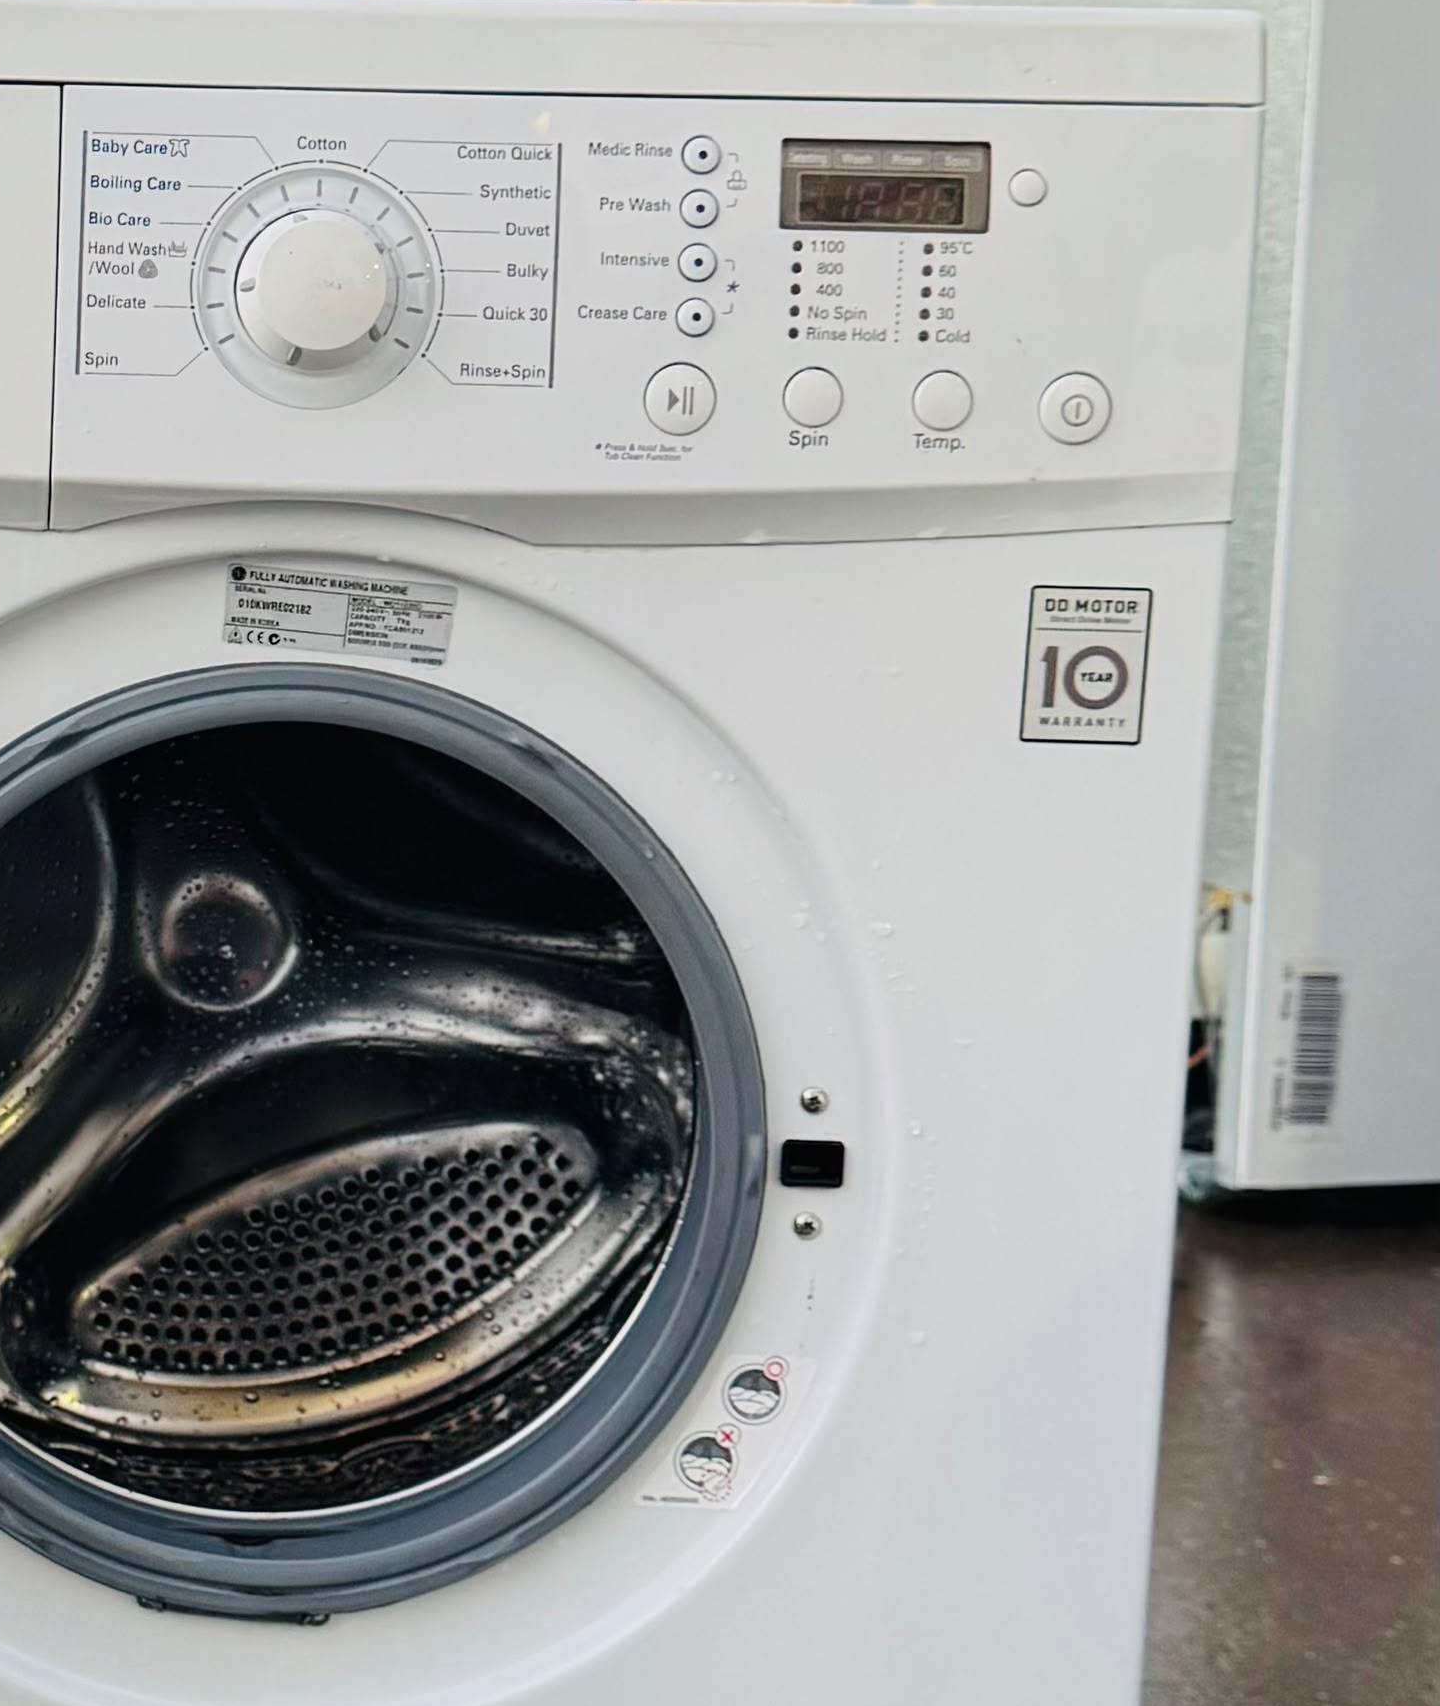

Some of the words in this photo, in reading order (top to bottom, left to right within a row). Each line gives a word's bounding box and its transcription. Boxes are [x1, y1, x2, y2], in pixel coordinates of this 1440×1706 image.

[91, 139, 129, 157] Baby
[133, 140, 168, 156] Care
[296, 136, 347, 151] Cotton
[588, 142, 631, 159] Medic
[634, 142, 673, 160] Rinse
[457, 146, 506, 160] Cotton
[510, 146, 552, 162] Quick
[90, 175, 143, 194] Boiling
[147, 177, 181, 191] Care
[480, 184, 551, 201] Synthetic
[600, 196, 622, 212] Pre
[627, 197, 671, 213] Wash
[88, 212, 112, 226] Bio
[115, 213, 151, 227] Care
[505, 222, 550, 237] Duvet
[88, 241, 124, 257] Hand
[127, 241, 167, 257] Wash
[811, 240, 845, 253] 1100
[88, 261, 135, 276] /Wool
[600, 252, 669, 269] Intensive
[816, 262, 844, 275] 800
[507, 264, 549, 281] Bulky
[939, 265, 956, 277] 60
[816, 284, 843, 296] 400
[938, 287, 955, 298] 40
[86, 294, 146, 310] Delicate
[483, 306, 525, 323] Quick
[529, 307, 548, 321] 30
[577, 305, 629, 321] Crease
[633, 306, 667, 322] Care
[807, 307, 829, 319] No
[833, 307, 867, 323] Spin
[936, 308, 954, 320] 30
[806, 327, 847, 341] Rinse
[852, 328, 886, 342] Hold
[935, 330, 970, 343] Cold
[85, 352, 119, 369] Spin
[460, 364, 546, 381] Rinse+Spin
[789, 429, 829, 450] Spin
[913, 433, 966, 453] Temp.
[249, 571, 276, 582] FULLY
[278, 574, 328, 587] AUTOMATIC
[330, 578, 369, 592] WASHING
[370, 582, 408, 596] MACHINE
[1045, 599, 1069, 612] DD
[1075, 599, 1138, 614] MOTOR
[1040, 645, 1129, 710] 10
[1080, 672, 1113, 683] YEAR
[1039, 716, 1126, 728] WARRANTY
